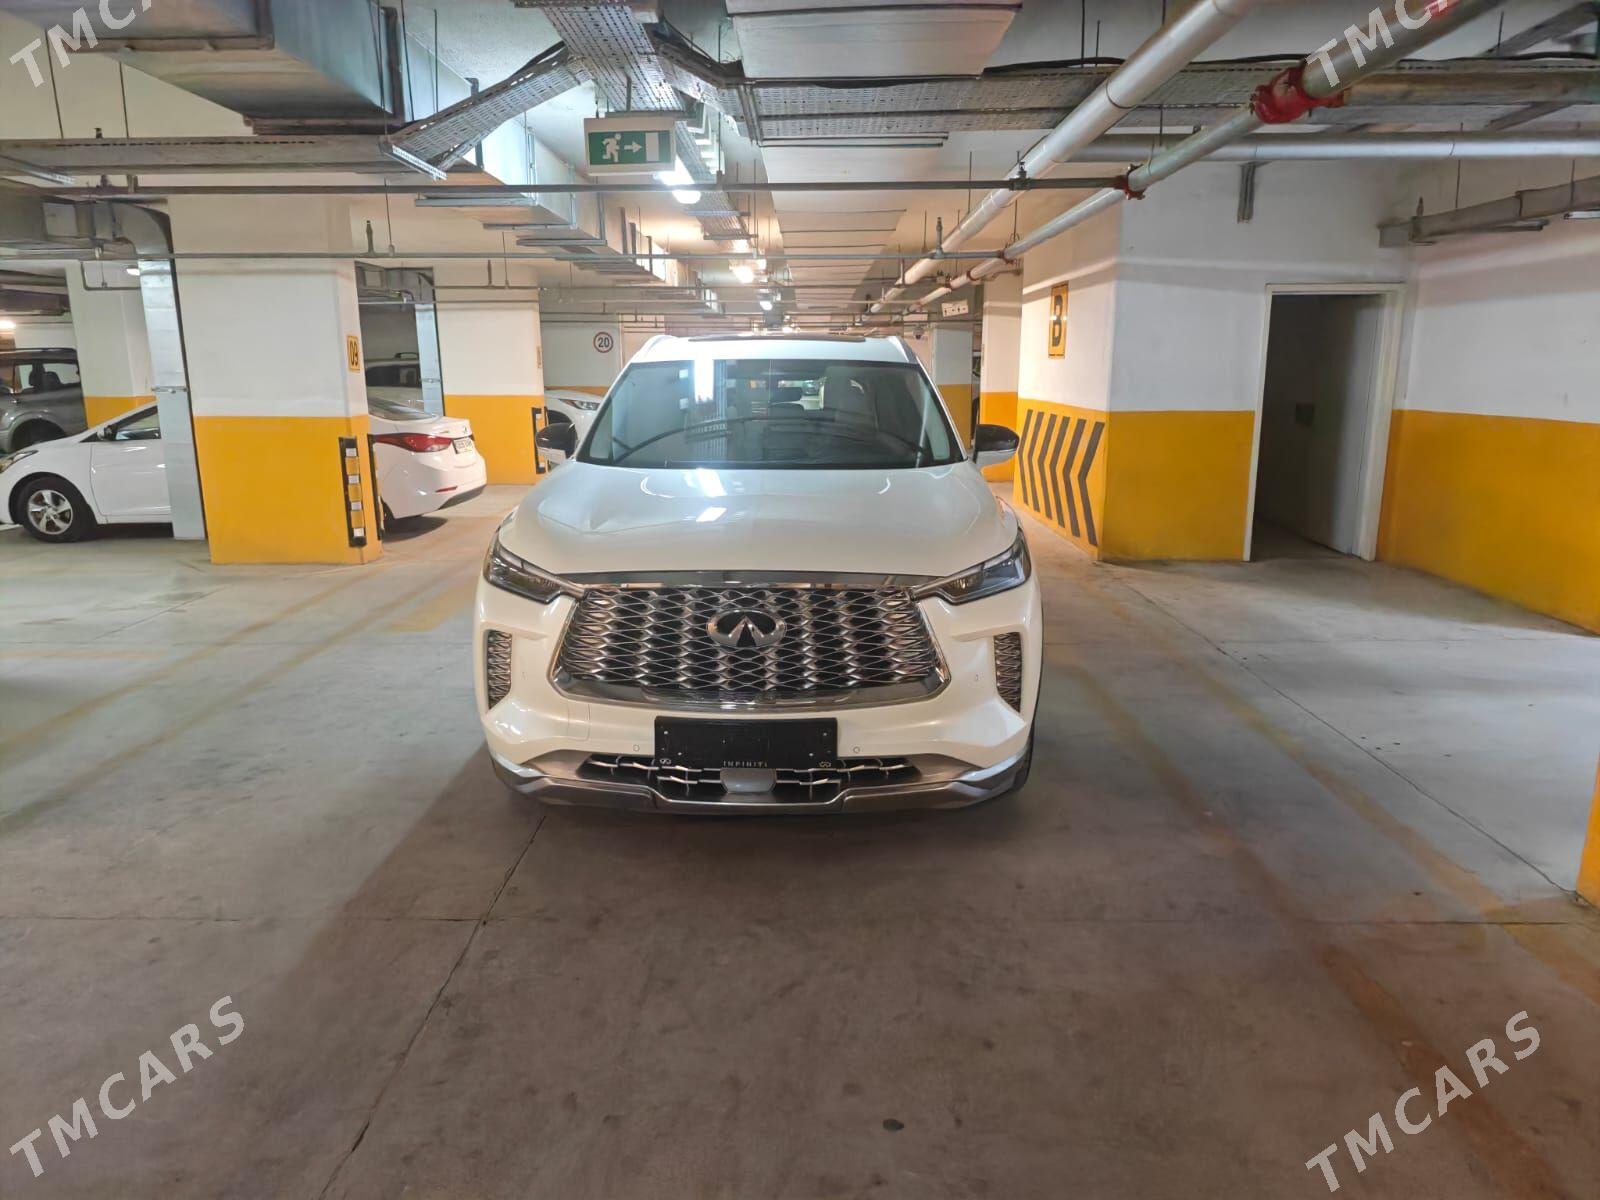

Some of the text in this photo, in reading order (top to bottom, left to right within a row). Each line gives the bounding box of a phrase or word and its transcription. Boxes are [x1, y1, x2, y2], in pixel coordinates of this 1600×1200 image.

[1051, 294, 1063, 347] B
[597, 337, 610, 348] 20
[723, 760, 768, 768] INFINITI
